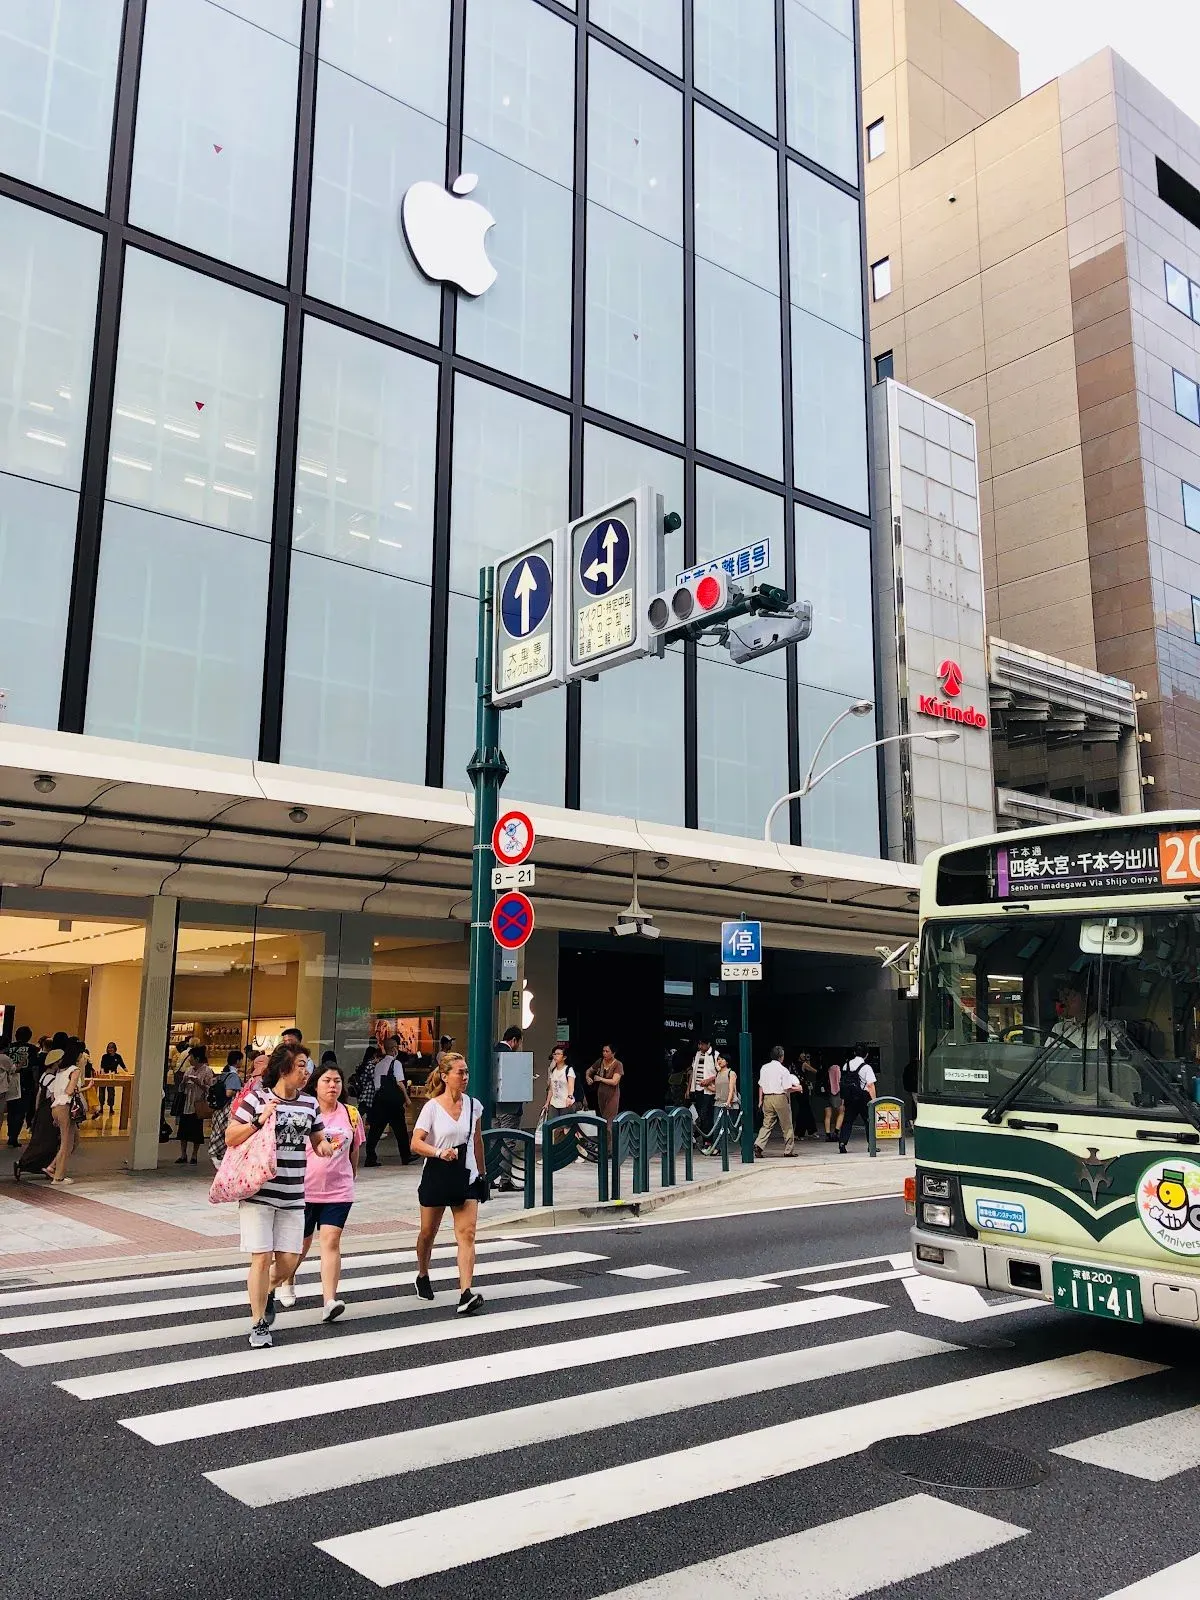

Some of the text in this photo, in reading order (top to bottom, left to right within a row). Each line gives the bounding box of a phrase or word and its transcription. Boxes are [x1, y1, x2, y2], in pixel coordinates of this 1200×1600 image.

[919, 694, 987, 729] Kirindo
[1010, 846, 1042, 857] 千本通
[1010, 847, 1159, 878] 四条大宮・千本今出川
[1010, 875, 1158, 892] Senbon Imadegawa Via Shijo Omiya
[728, 927, 755, 957] 停
[723, 966, 760, 978] ここから
[1071, 1280, 1134, 1319] 11-41
